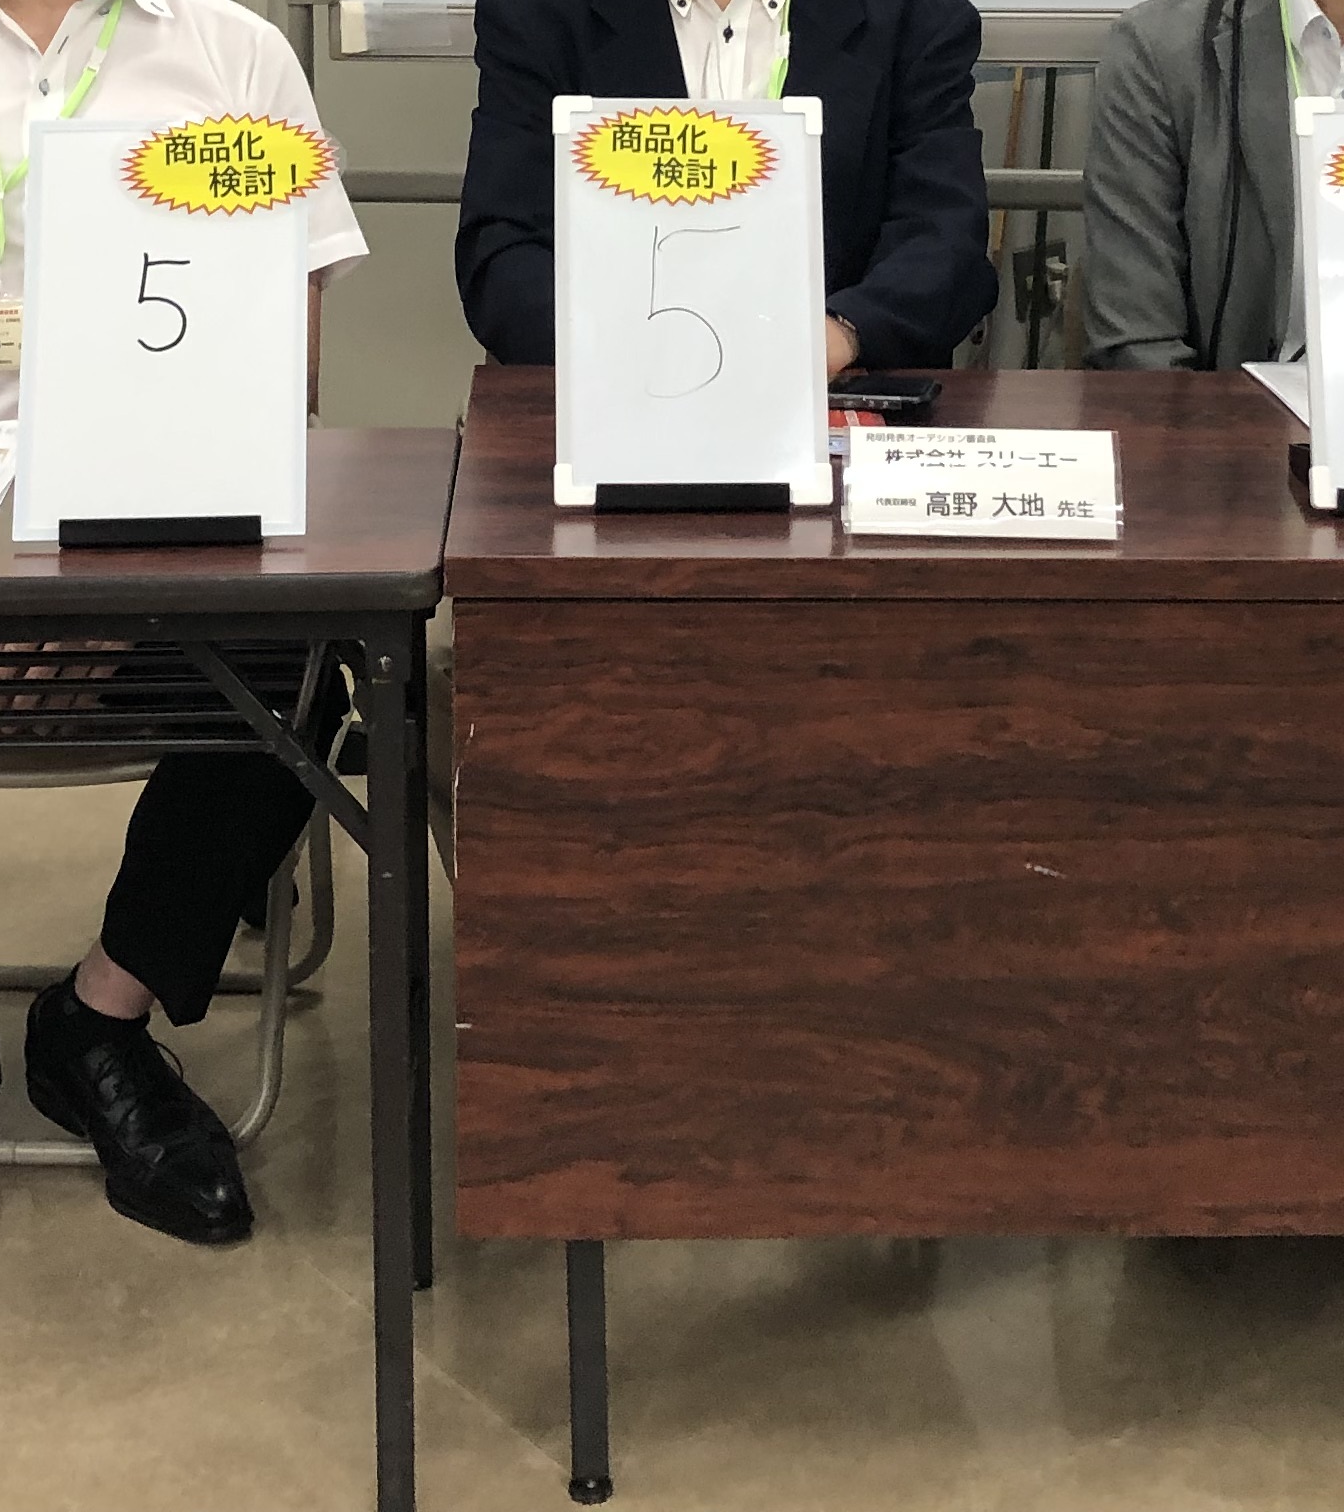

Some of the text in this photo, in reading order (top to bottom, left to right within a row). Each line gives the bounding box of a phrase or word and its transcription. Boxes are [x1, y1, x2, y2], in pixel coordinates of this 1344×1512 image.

[165, 132, 265, 165] 商品化
[612, 124, 708, 154] 商品化
[137, 252, 190, 352] 5
[645, 225, 740, 398] 5
[926, 491, 978, 517] 高野
[992, 493, 1044, 517] 大地
[1057, 500, 1095, 518] 先生
